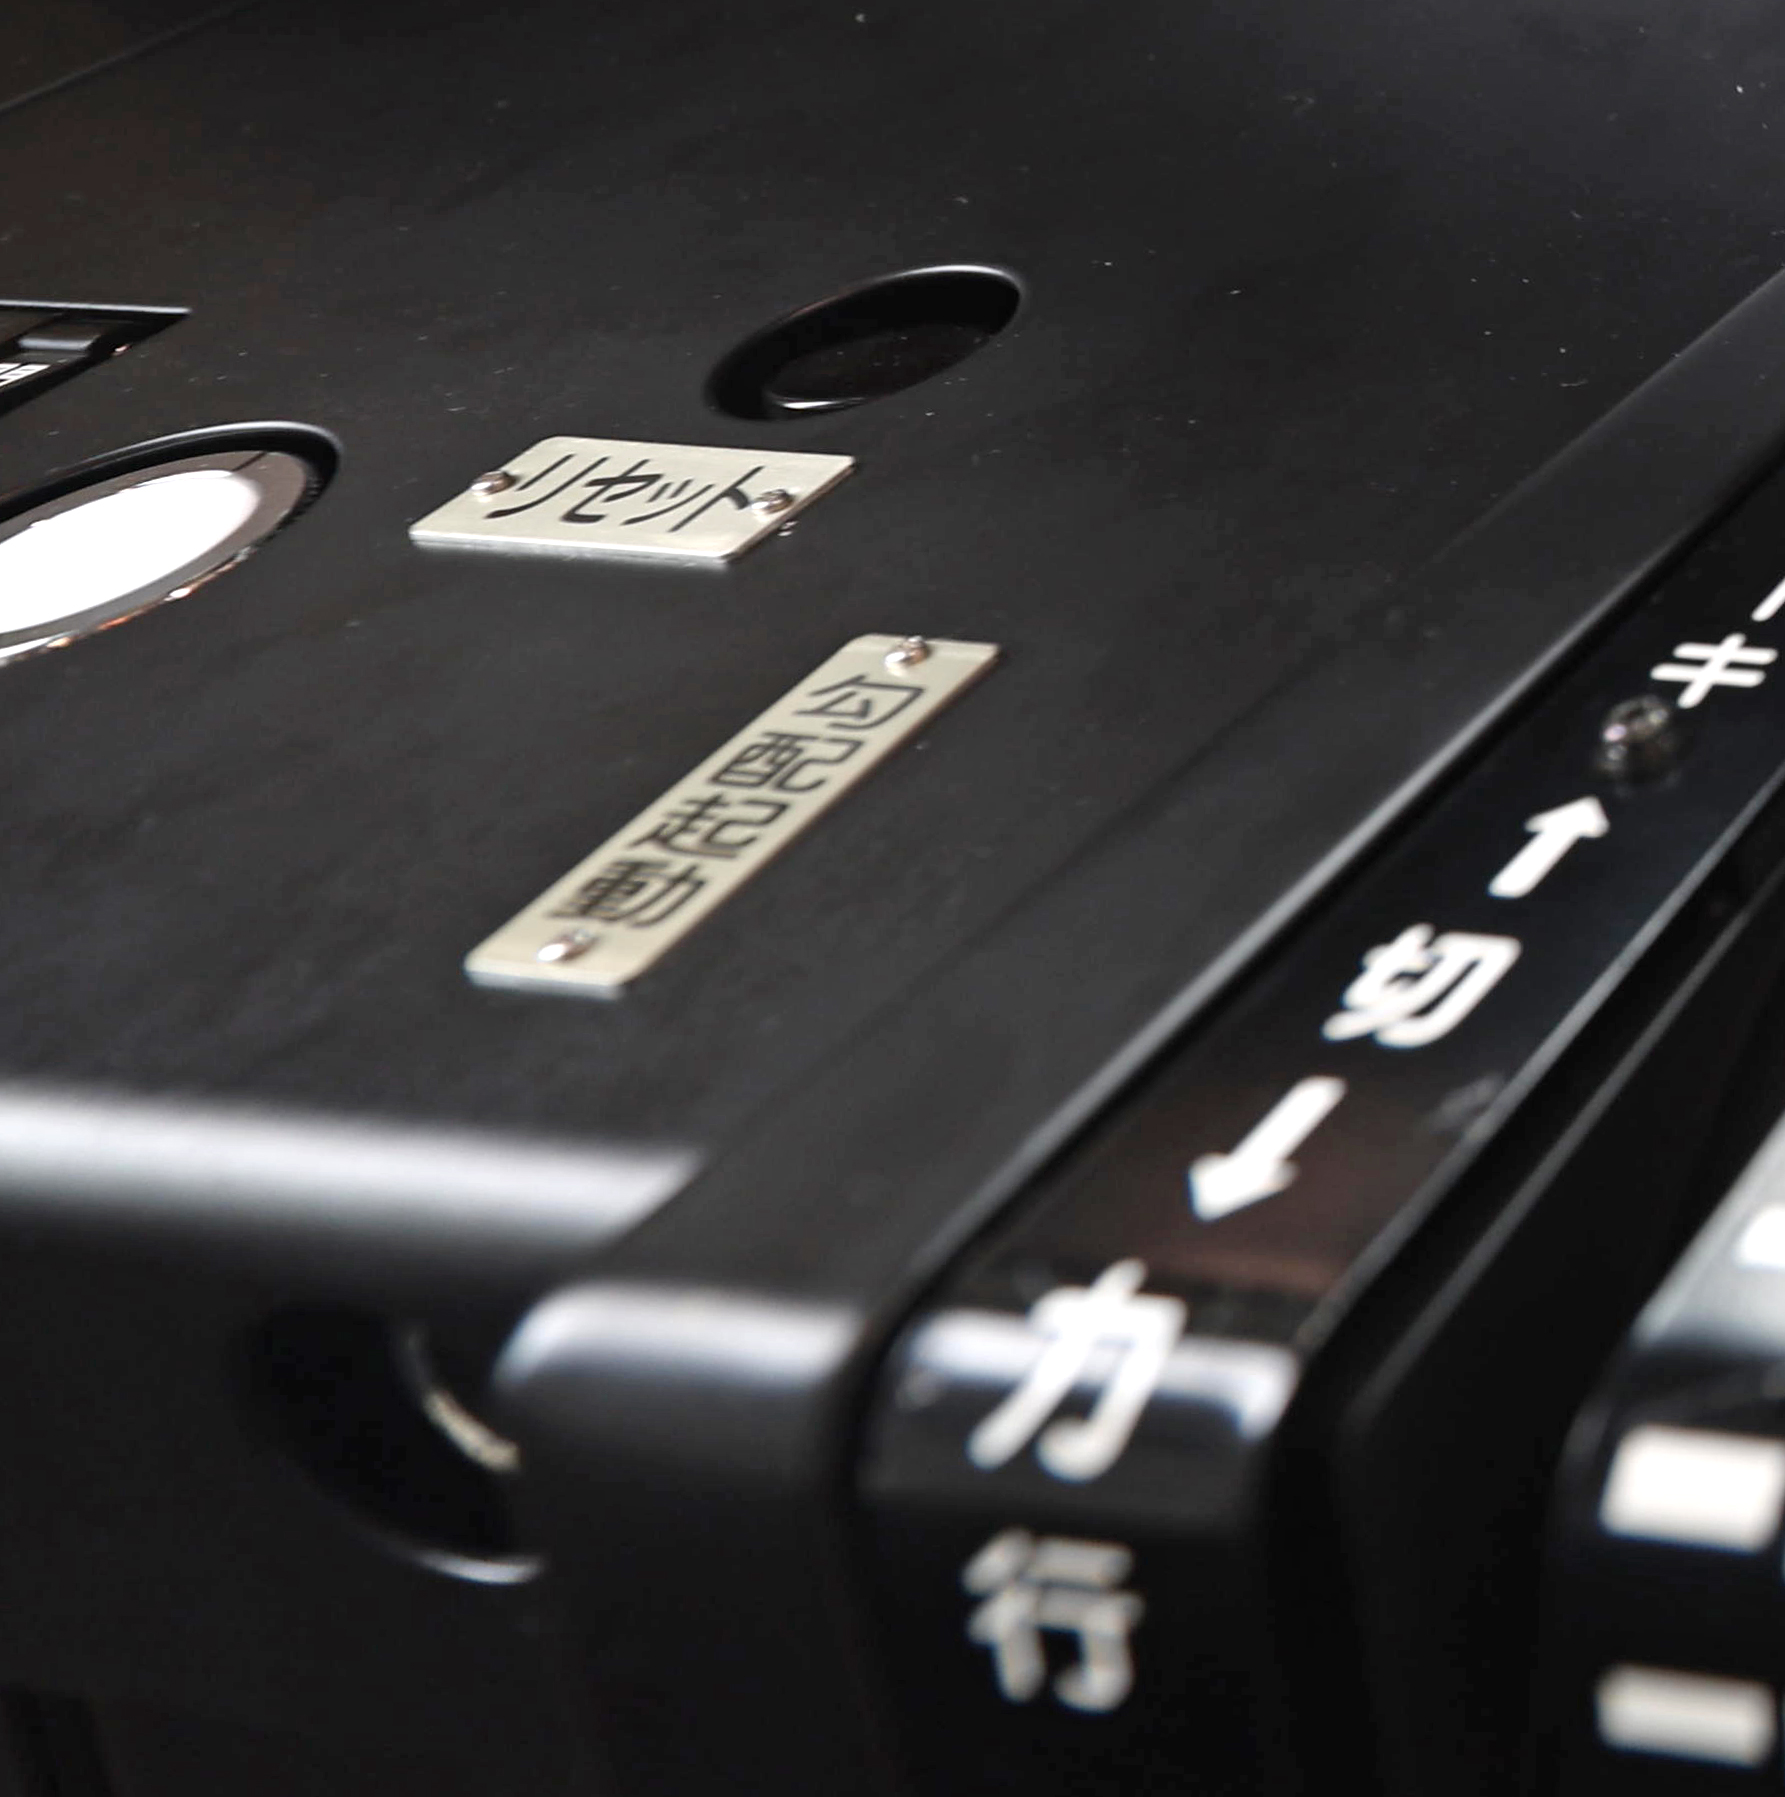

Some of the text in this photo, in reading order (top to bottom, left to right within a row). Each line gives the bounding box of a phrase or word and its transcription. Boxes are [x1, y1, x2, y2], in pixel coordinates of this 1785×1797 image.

[485, 453, 765, 533] リセット
[547, 674, 926, 929] 勾配起動
[1322, 922, 1522, 1048] 切
